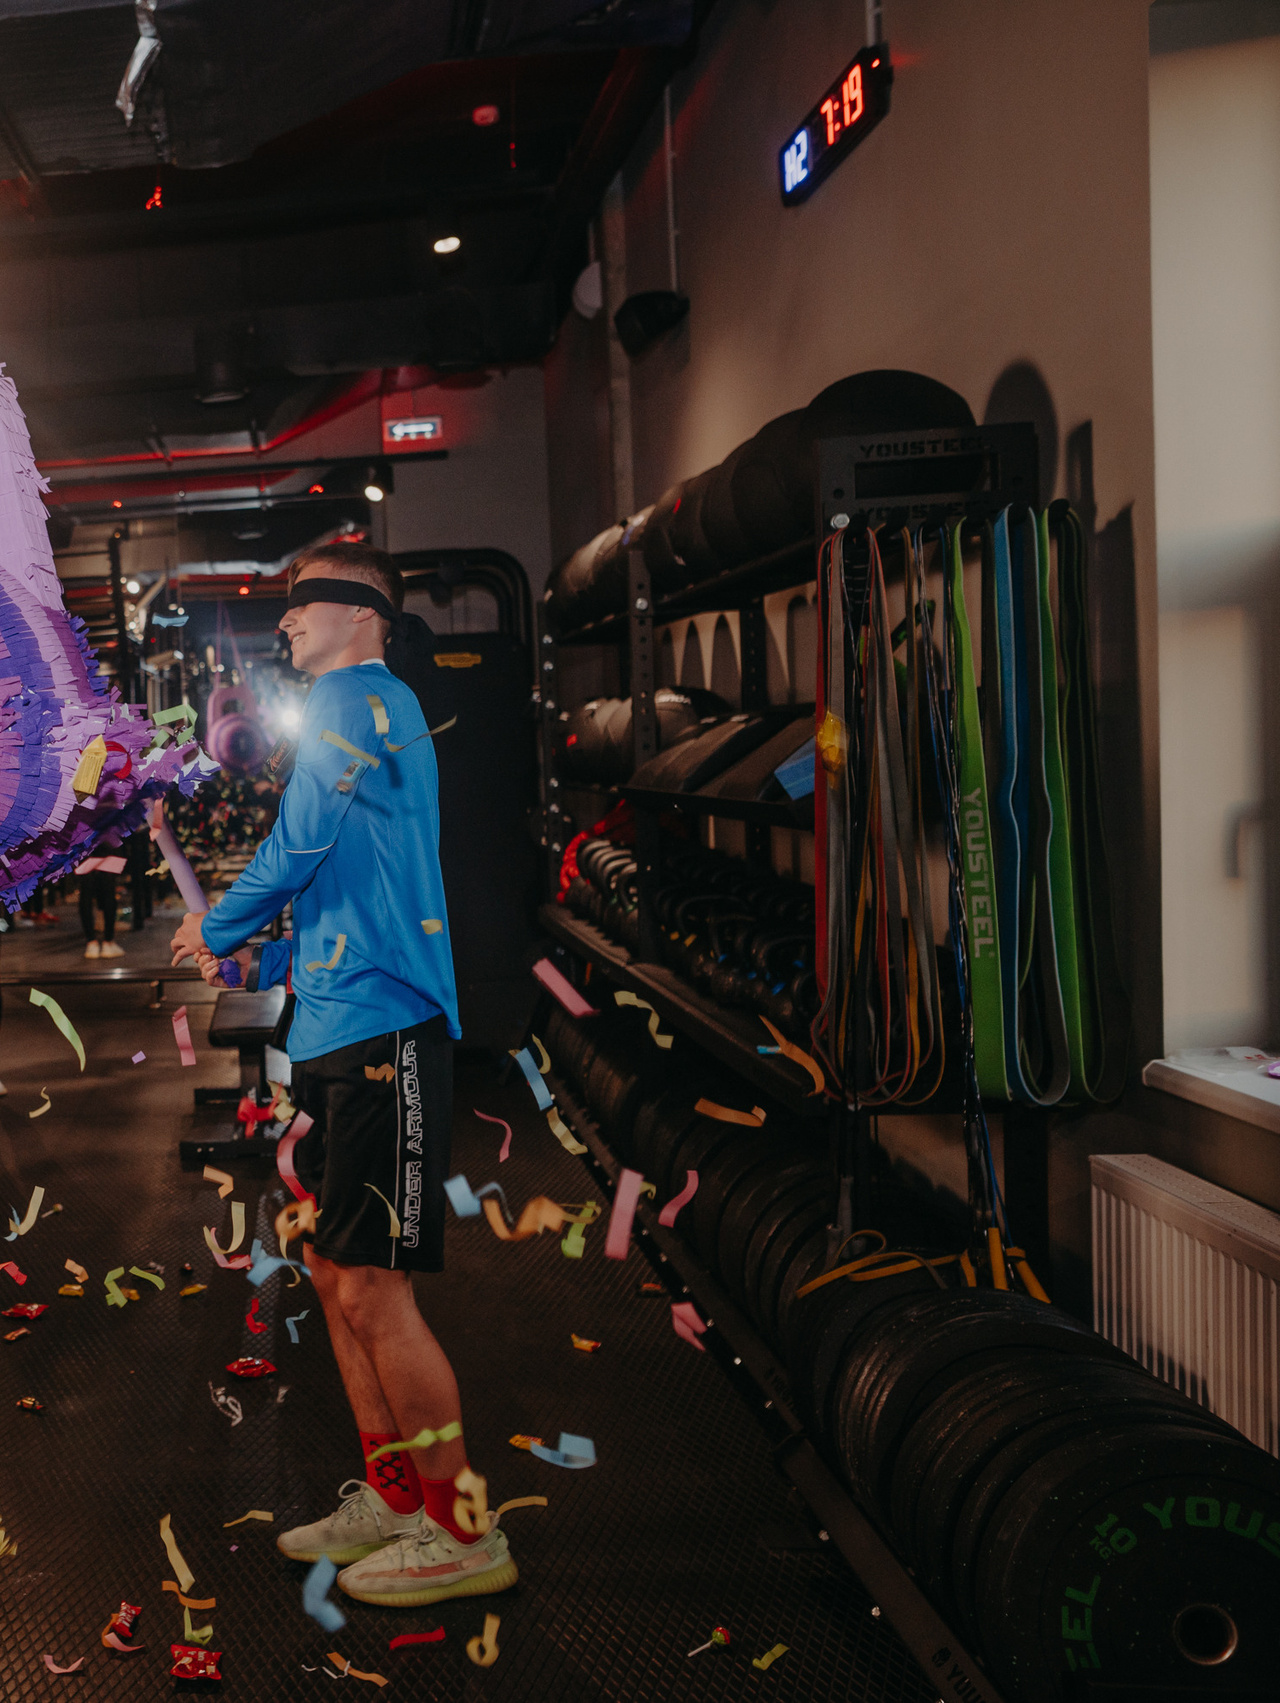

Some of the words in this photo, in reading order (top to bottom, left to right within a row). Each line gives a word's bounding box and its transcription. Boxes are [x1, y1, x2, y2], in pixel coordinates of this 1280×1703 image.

[820, 63, 864, 146] 7:19
[962, 787, 994, 959] YOUSTEEL
[402, 1039, 423, 1155] ARMOUR
[402, 1161, 423, 1249] UNDER
[1094, 1513, 1138, 1554] 10
